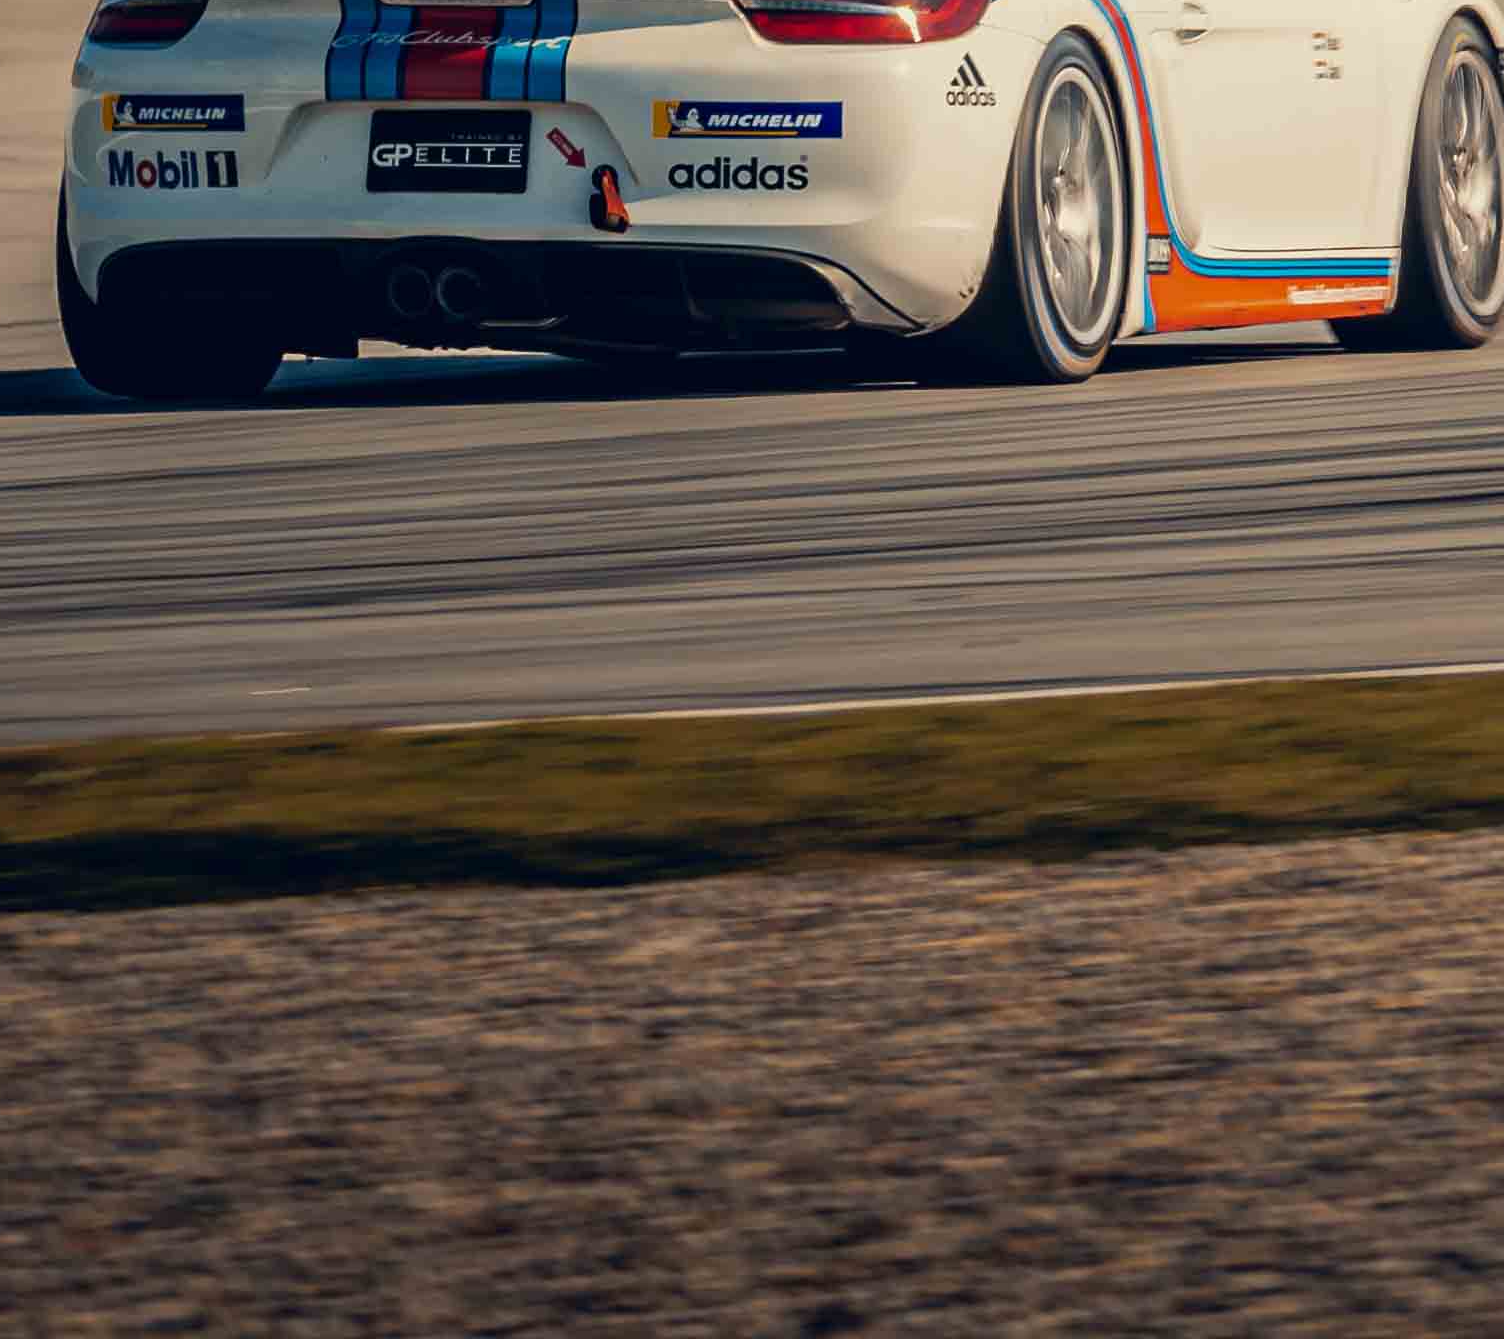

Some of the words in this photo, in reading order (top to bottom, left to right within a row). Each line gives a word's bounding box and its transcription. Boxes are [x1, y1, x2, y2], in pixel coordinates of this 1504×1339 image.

[945, 89, 997, 107] adidas
[138, 107, 226, 121] MICHELIN
[707, 114, 823, 128] MICHELIN
[108, 149, 200, 189] Mobil
[668, 156, 809, 191] adidas
